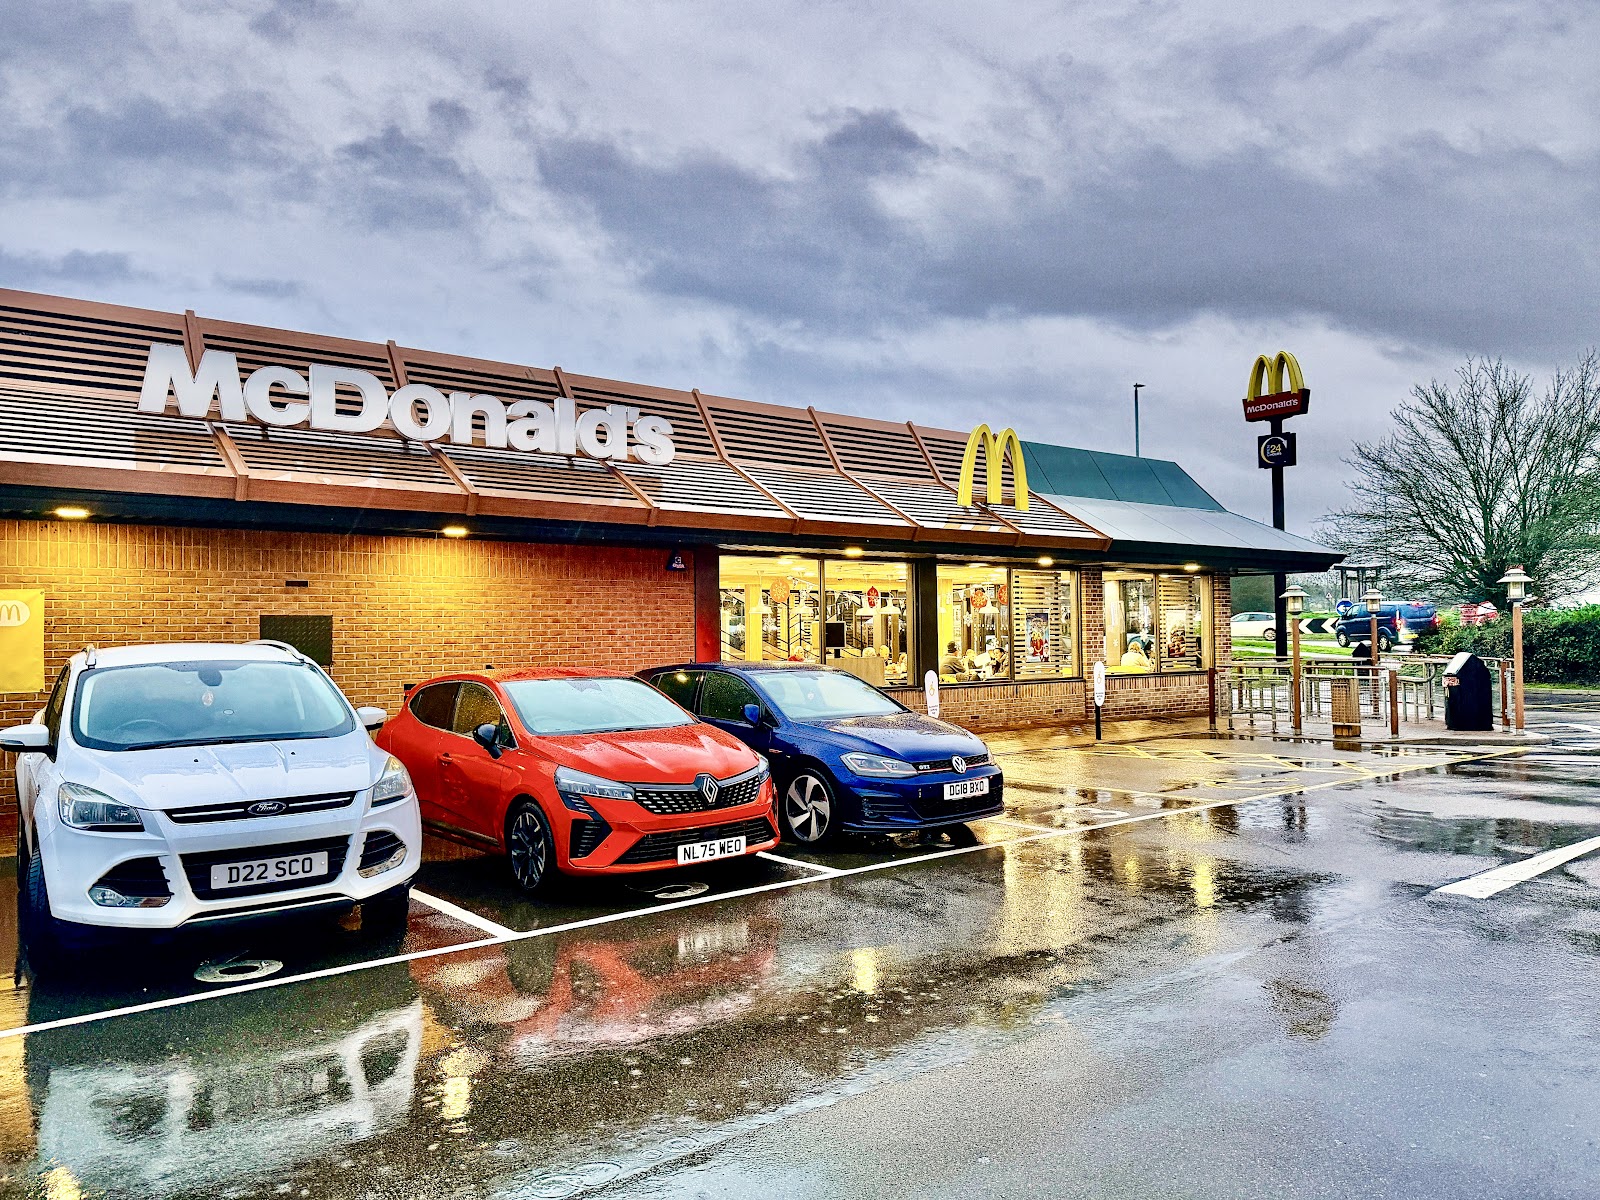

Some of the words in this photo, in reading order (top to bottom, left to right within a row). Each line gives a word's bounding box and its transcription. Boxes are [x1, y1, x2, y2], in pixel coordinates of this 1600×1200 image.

[137, 342, 676, 466] McDonald's
[1247, 399, 1298, 413] McDonald's
[1270, 444, 1281, 454] 24
[949, 783, 967, 796] DG18
[969, 780, 984, 794] BXO
[256, 802, 279, 812] Ford
[683, 842, 715, 861] NL75
[719, 839, 741, 855] WEO
[227, 862, 268, 883] D22
[275, 857, 313, 878] SCO
